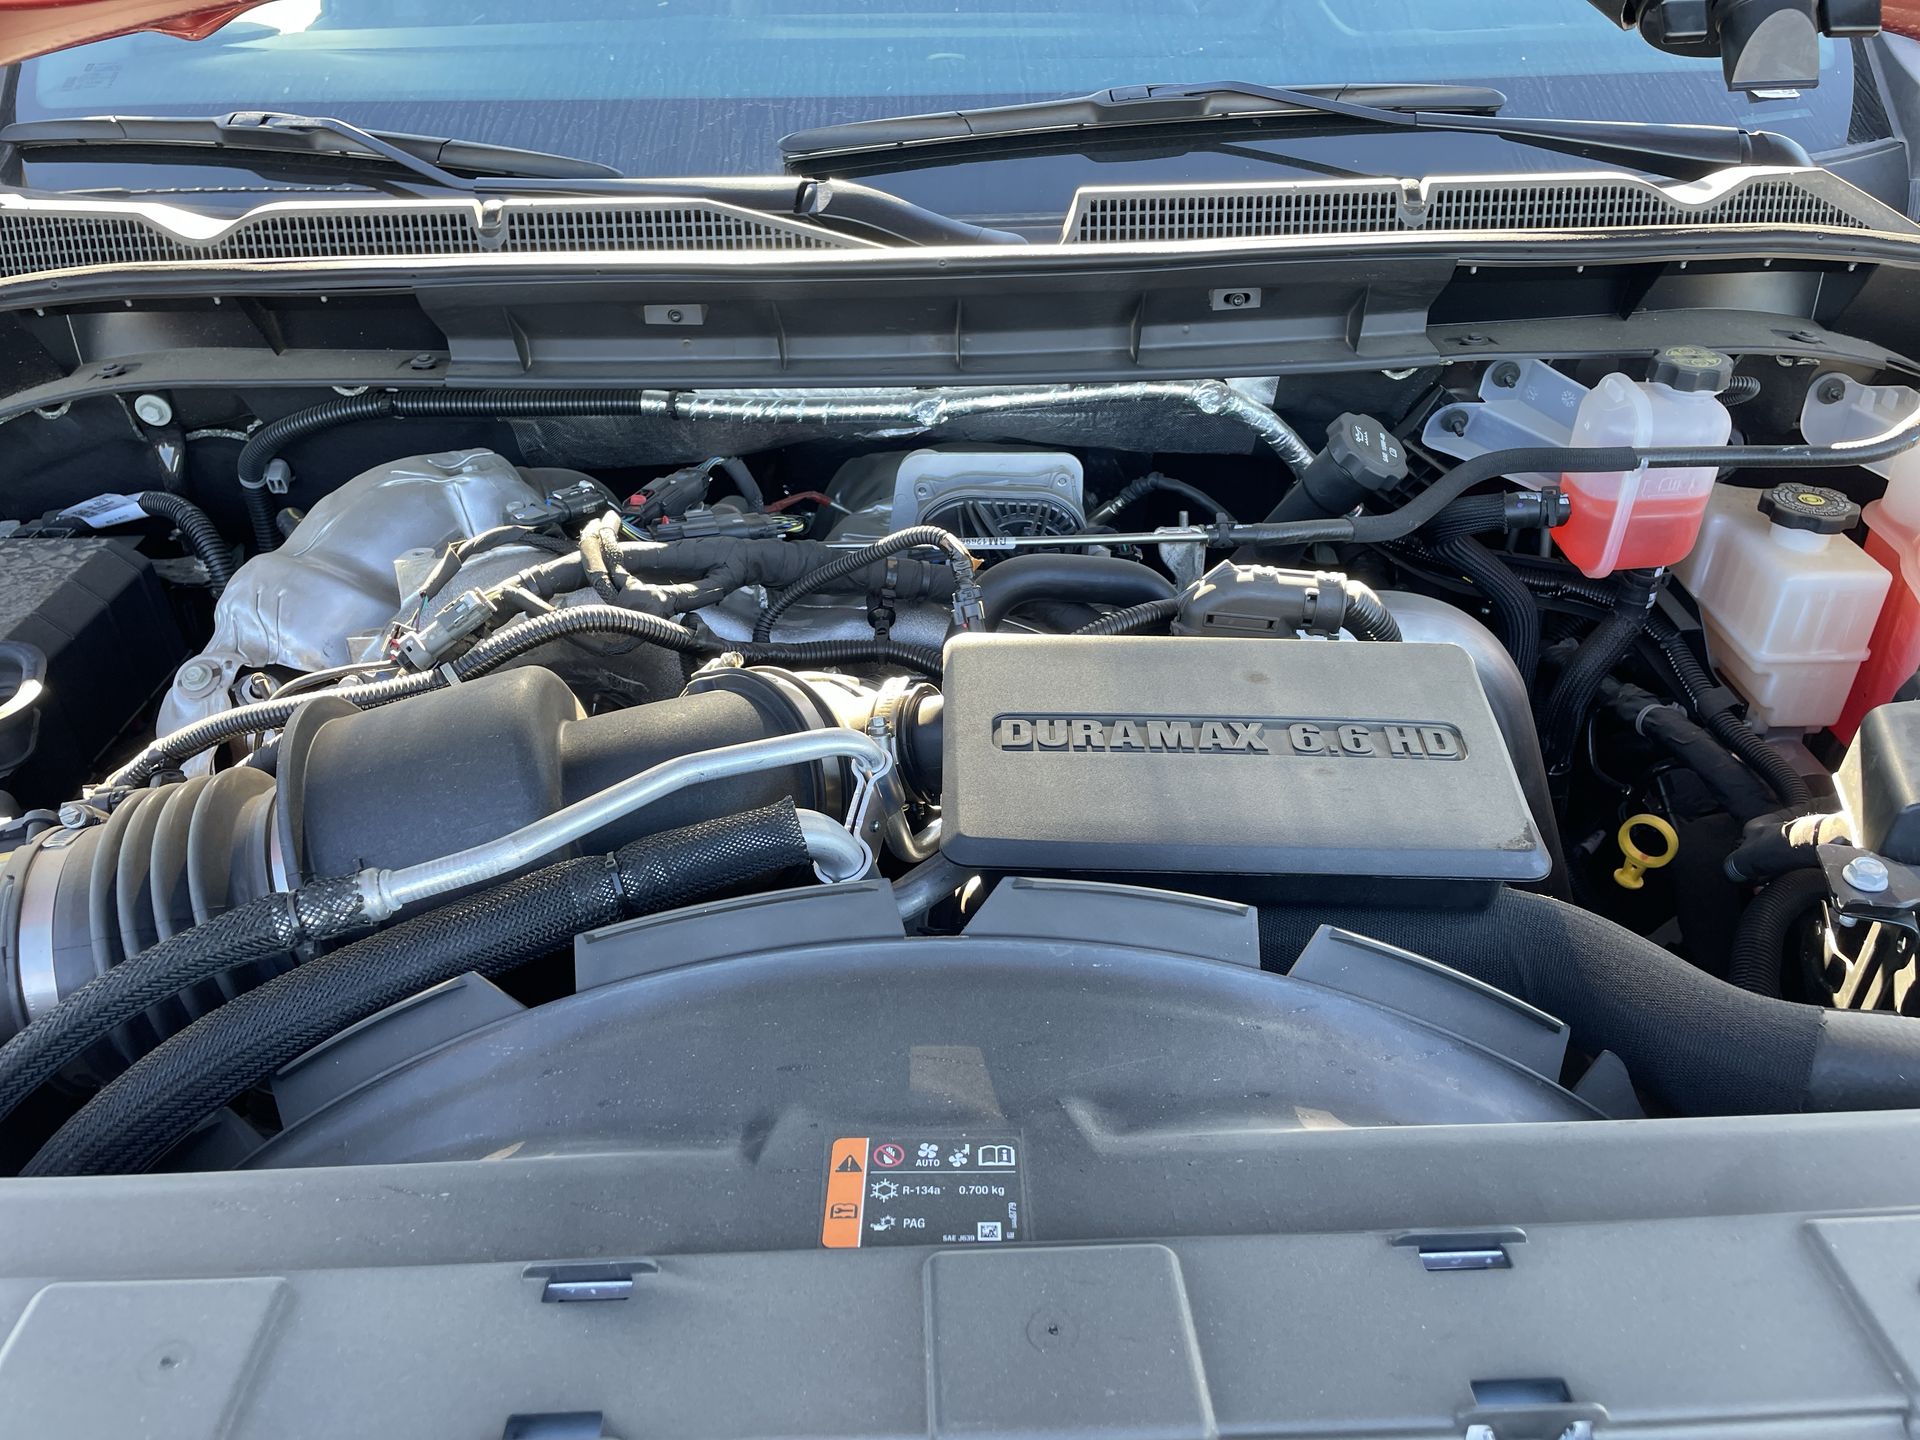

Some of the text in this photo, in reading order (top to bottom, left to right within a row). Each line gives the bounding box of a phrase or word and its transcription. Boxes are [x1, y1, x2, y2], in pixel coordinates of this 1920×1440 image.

[1000, 718, 1459, 757] DURAMAX 6.6 HD
[915, 1158, 941, 1167] AUTO
[902, 1185, 1005, 1197] R-134a 0.700 kg
[903, 1218, 926, 1228] PAG
[942, 1234, 957, 1242] SAE
